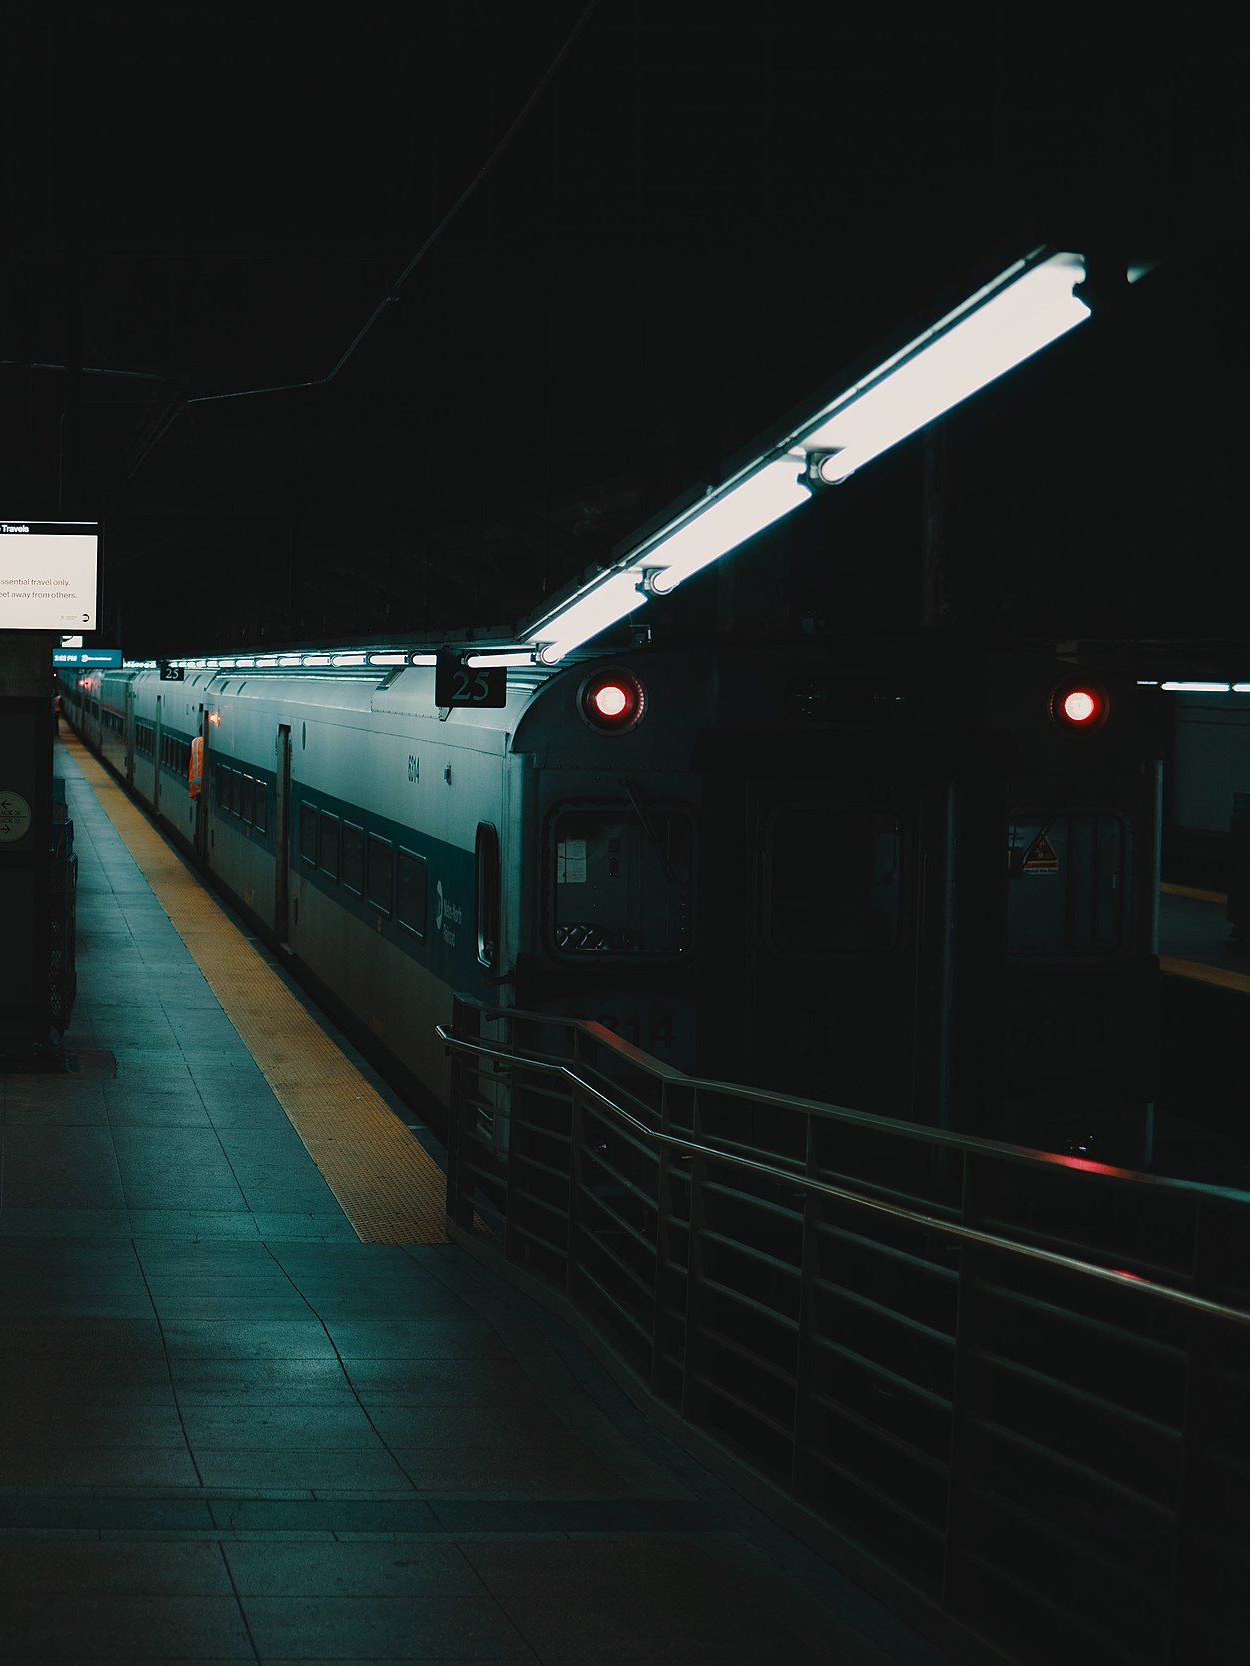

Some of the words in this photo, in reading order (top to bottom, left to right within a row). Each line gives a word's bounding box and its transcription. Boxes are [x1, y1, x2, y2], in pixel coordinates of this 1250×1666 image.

[1, 524, 29, 533] Travels
[53, 579, 71, 587] only.
[165, 668, 179, 680] 25
[452, 670, 490, 701] 25
[408, 754, 420, 783] 6314
